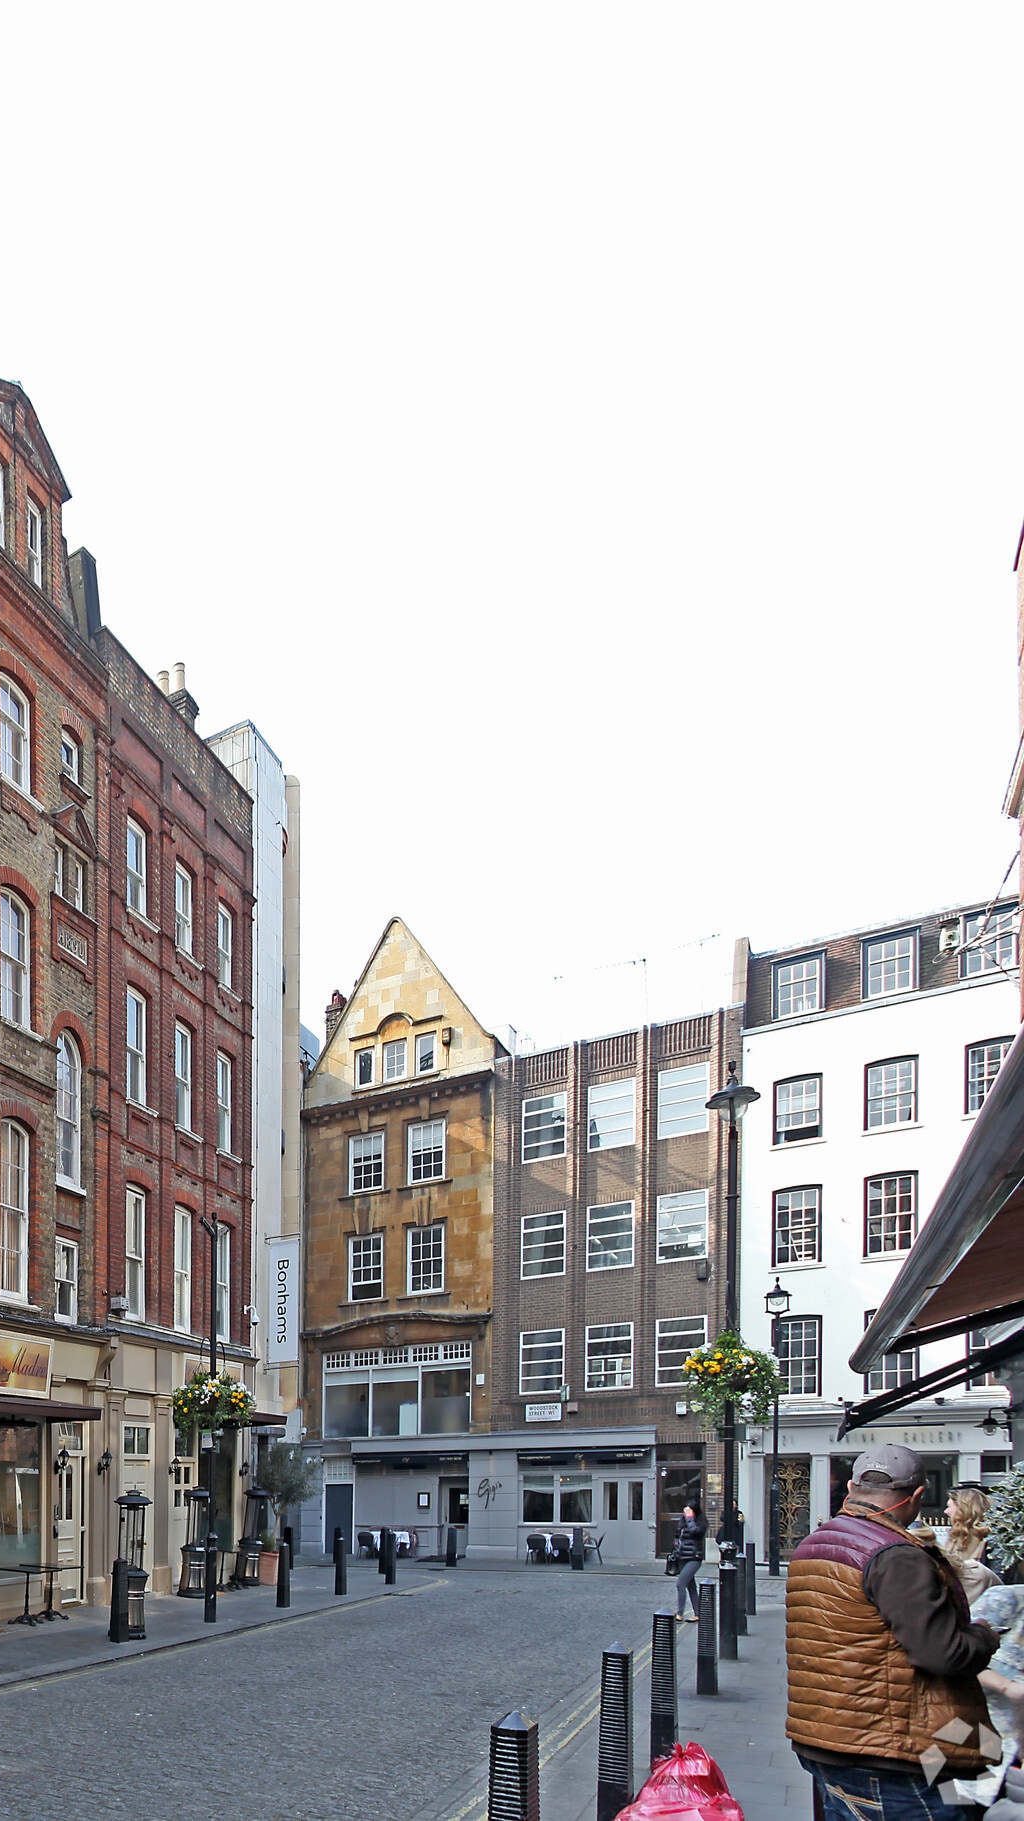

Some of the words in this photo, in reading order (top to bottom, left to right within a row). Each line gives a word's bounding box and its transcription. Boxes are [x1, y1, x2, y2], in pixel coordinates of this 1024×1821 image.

[276, 1258, 290, 1344] Bonhams
[11, 1346, 47, 1377] Madre
[903, 1431, 961, 1444] GALLERY
